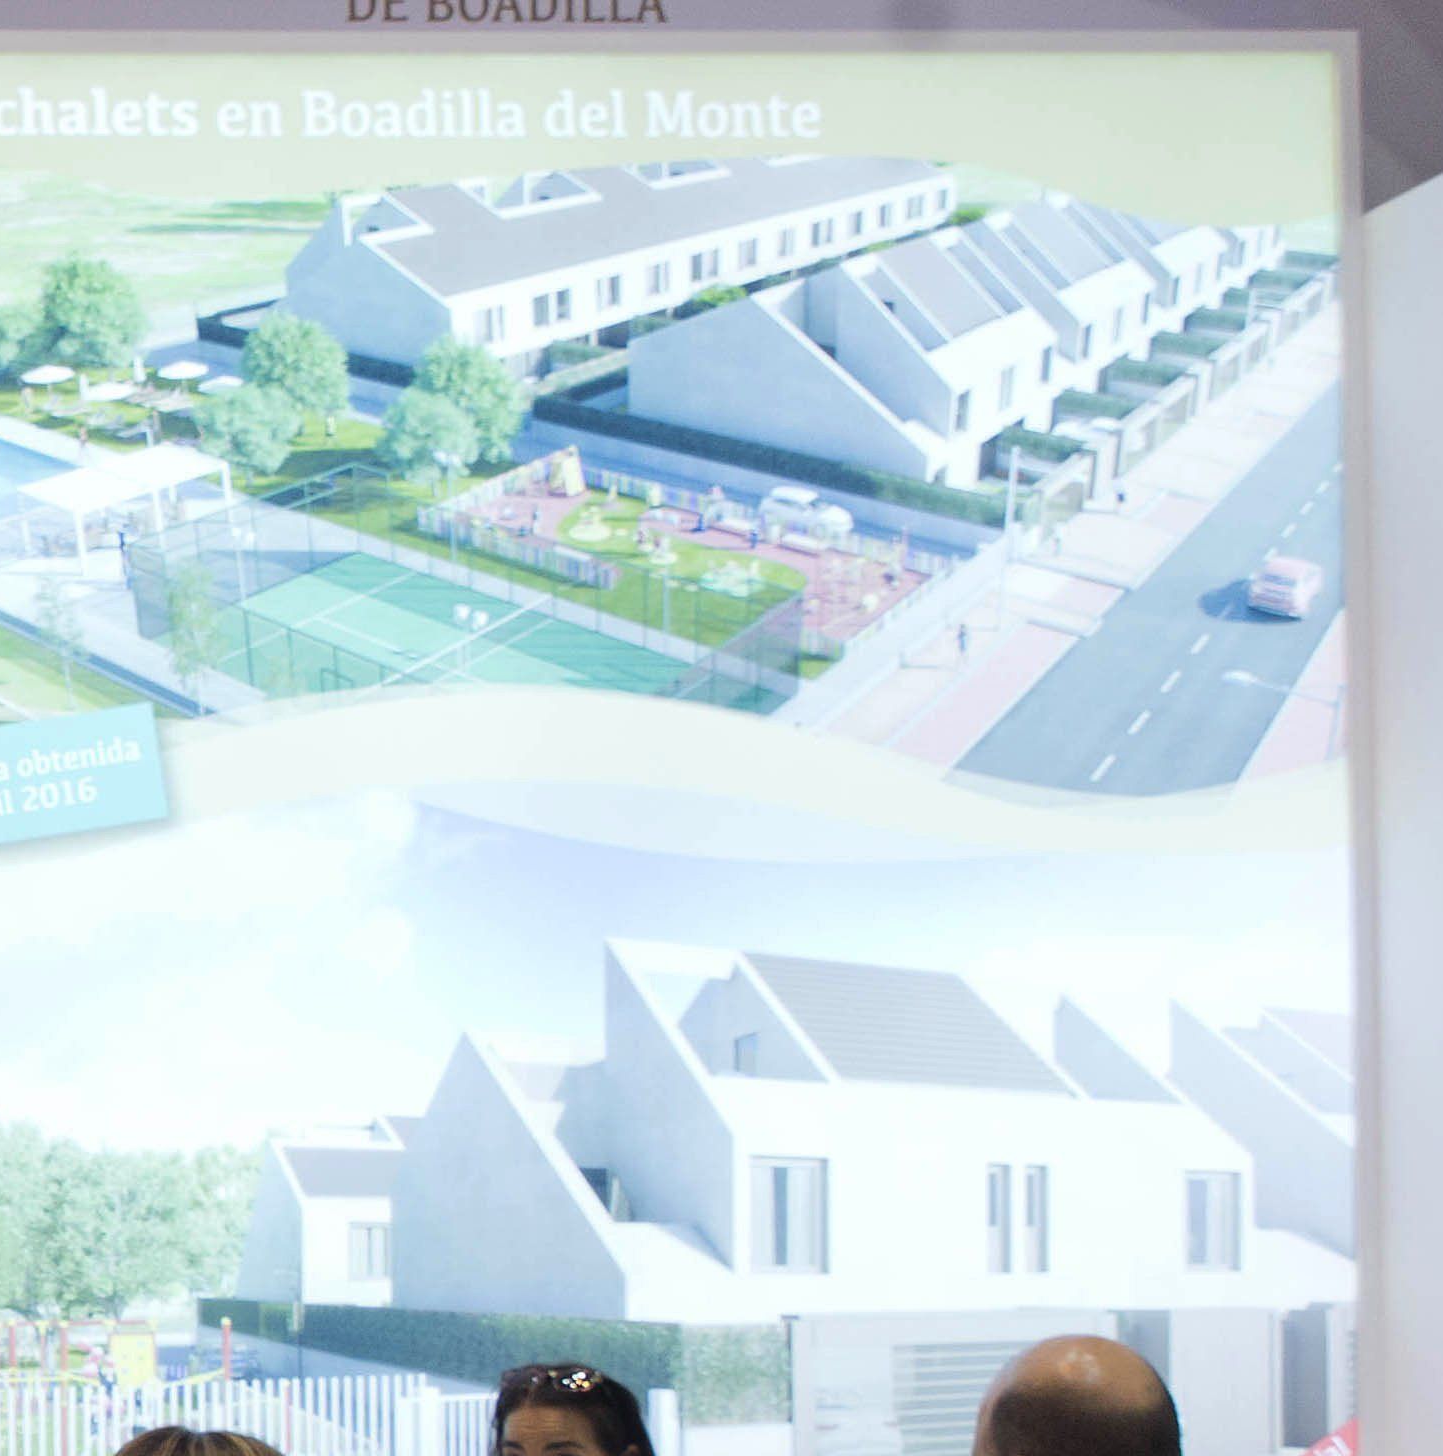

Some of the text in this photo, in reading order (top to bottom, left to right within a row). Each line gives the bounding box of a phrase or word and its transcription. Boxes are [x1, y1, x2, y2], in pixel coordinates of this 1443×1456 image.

[347, 0, 667, 24] DE BOADILLA
[216, 98, 284, 138] en
[301, 87, 527, 140] Boadilla
[544, 88, 626, 140] del
[643, 91, 821, 140] Monte
[17, 737, 141, 777] obtenida
[21, 776, 98, 812] 2016
